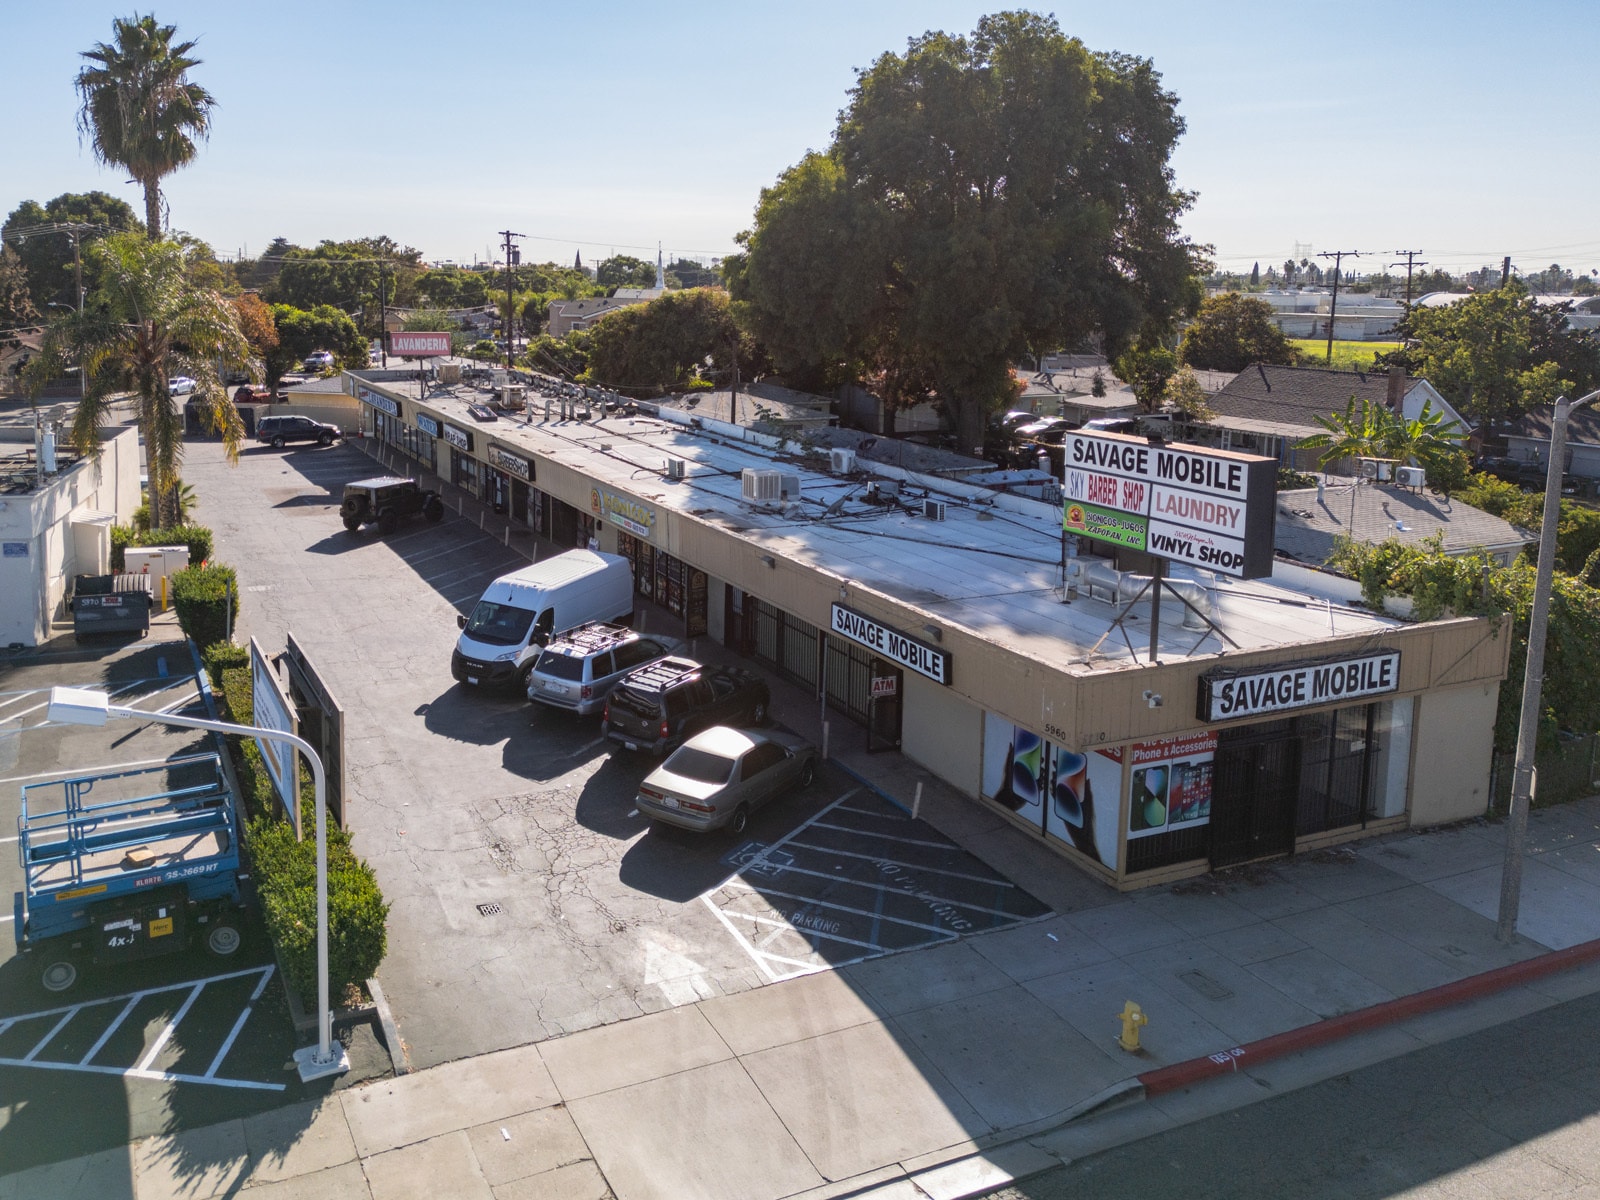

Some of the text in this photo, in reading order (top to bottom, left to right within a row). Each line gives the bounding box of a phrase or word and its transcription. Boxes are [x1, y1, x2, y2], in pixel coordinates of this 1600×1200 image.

[392, 337, 448, 351] LAVANDERIA
[1073, 438, 1242, 493] SAVAGE MOBILE
[1070, 470, 1144, 512] SKY BARBER SHOP
[1086, 511, 1117, 527] BIONICOS
[1156, 491, 1240, 528] LAUNDRY
[1151, 532, 1194, 558] VINYL
[1198, 545, 1244, 569] SHOP
[836, 609, 941, 677] SAVAGE MOBILE
[873, 679, 895, 692] ATM
[1220, 659, 1392, 714] SAVAGE MOBILE
[1044, 723, 1066, 740] 5960
[1163, 747, 1169, 756] &
[1170, 738, 1218, 756] Accessories
[791, 912, 841, 934] PARKING
